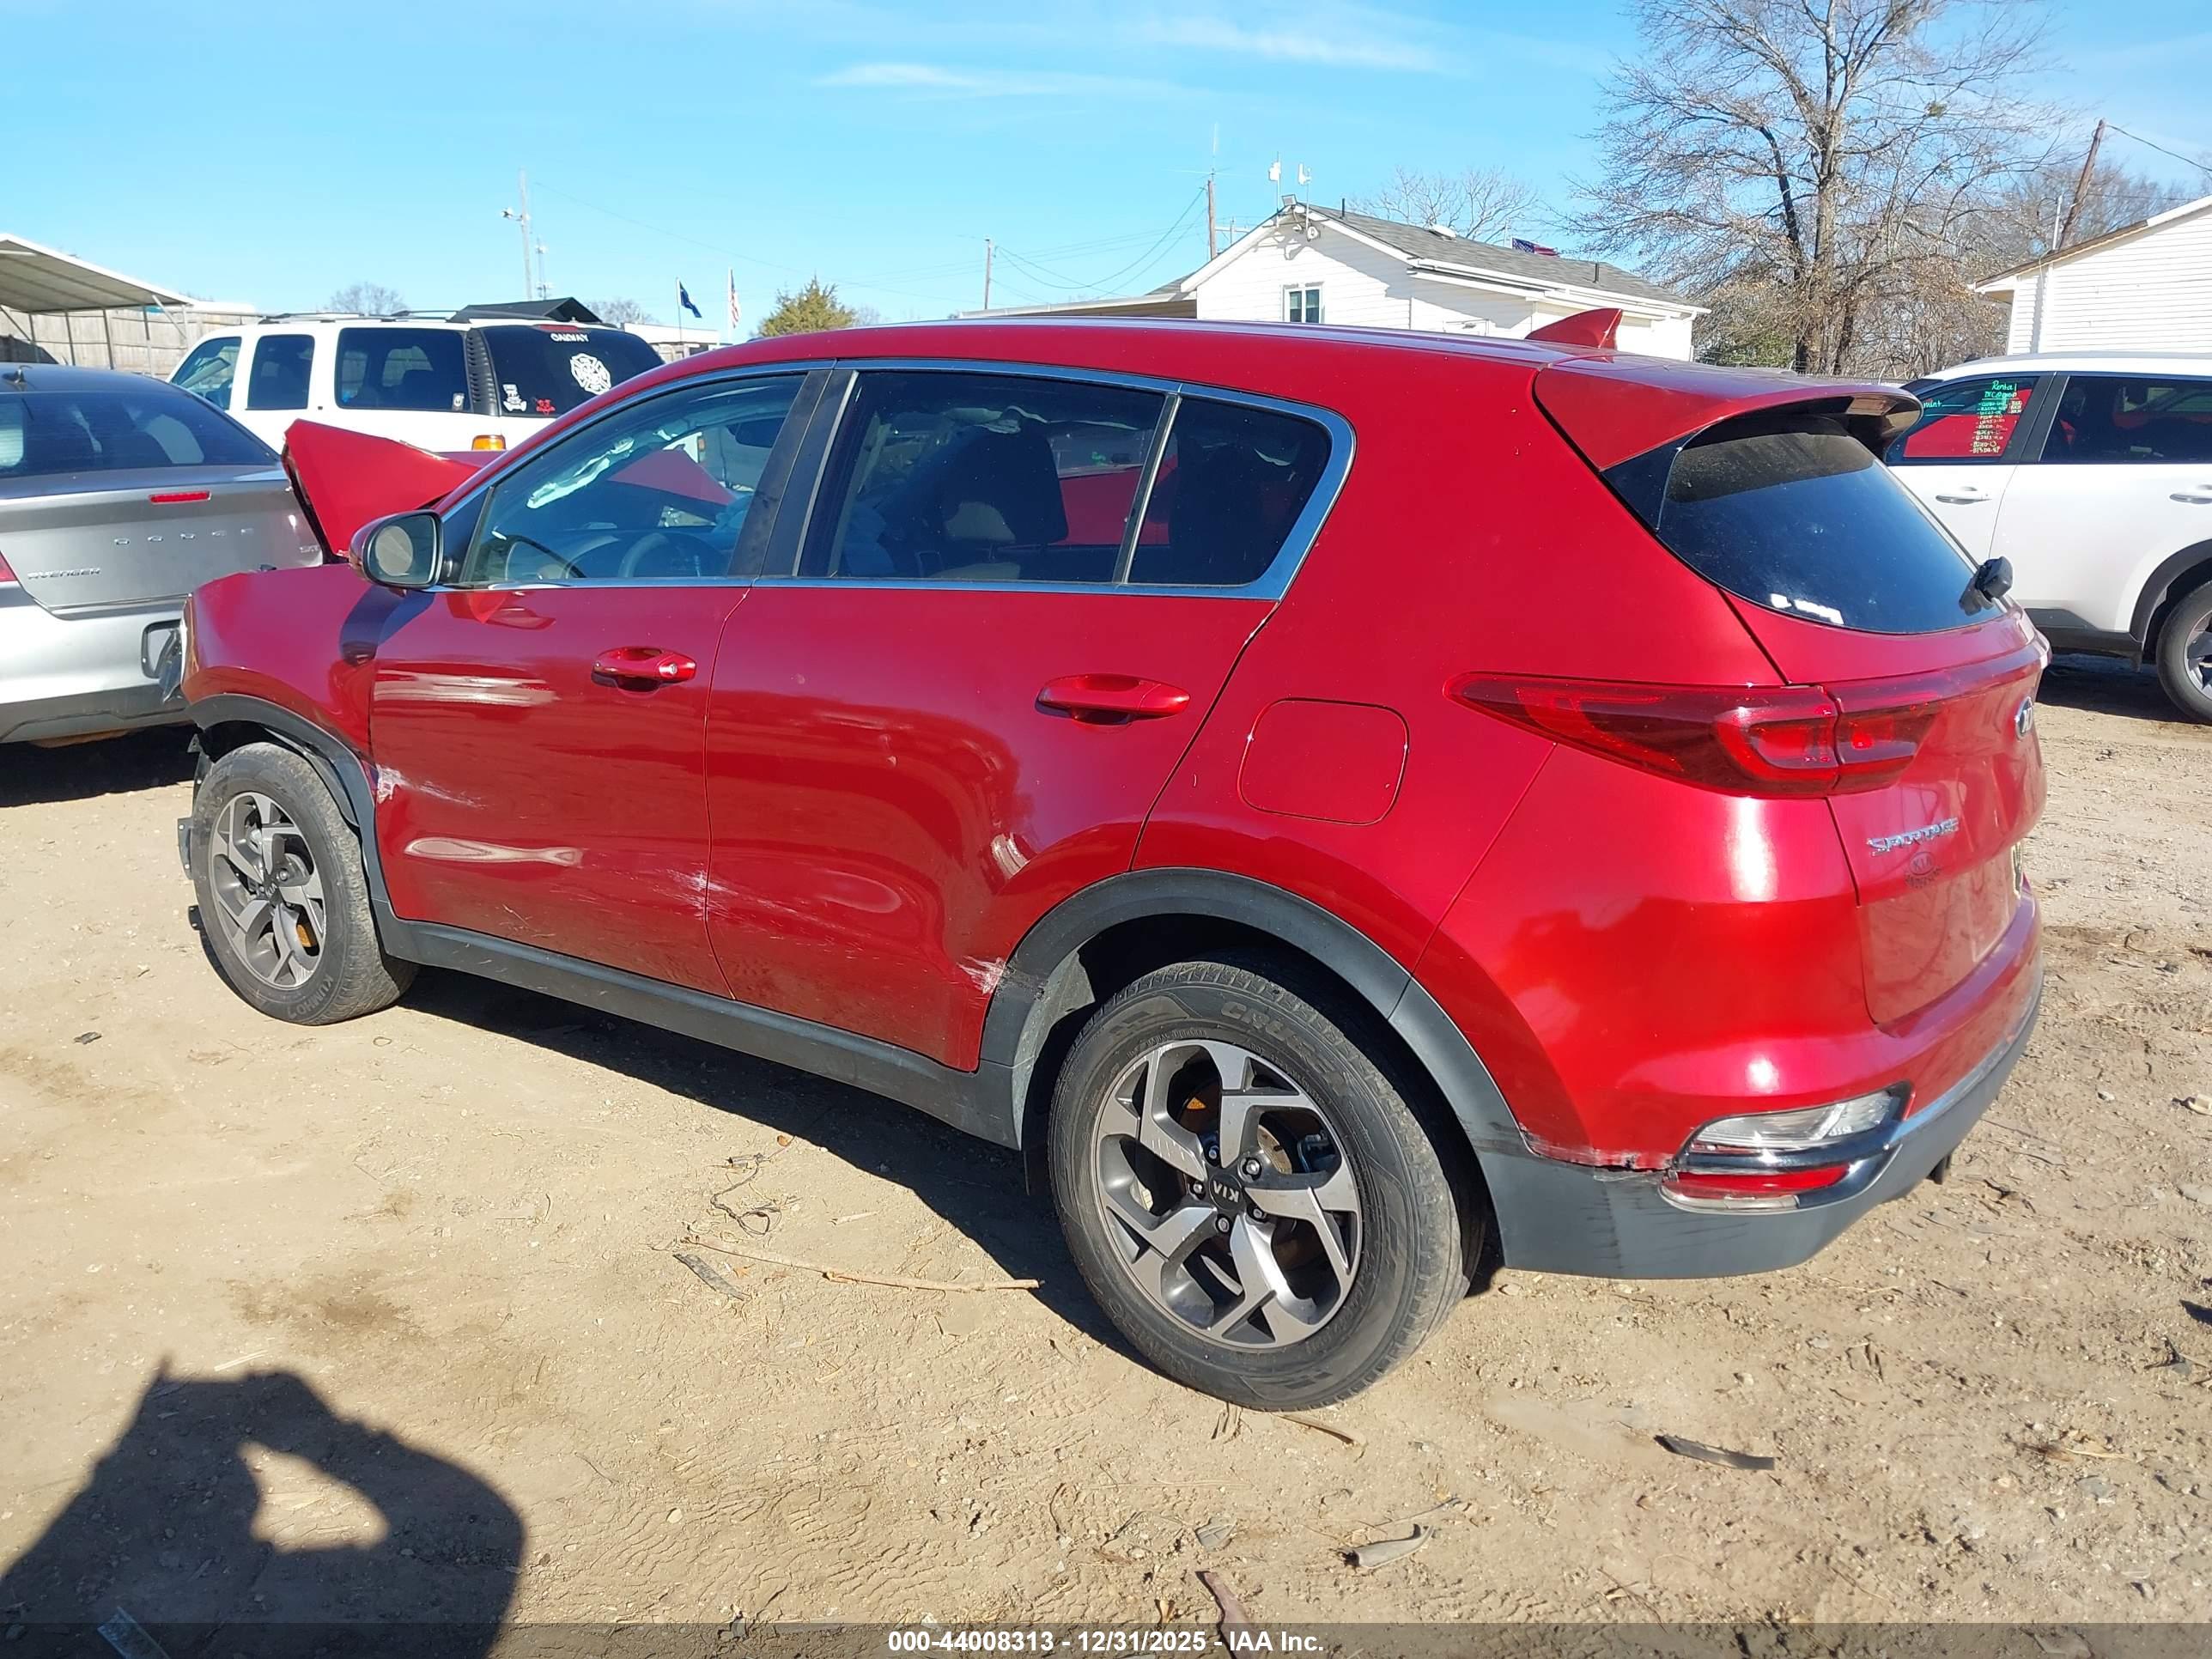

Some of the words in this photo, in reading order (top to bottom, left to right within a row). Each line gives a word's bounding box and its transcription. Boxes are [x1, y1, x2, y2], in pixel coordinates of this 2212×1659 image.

[27, 567, 100, 580] AVENGER
[1867, 817, 1959, 856] SPORTAGE
[264, 882, 278, 898] KIA
[1212, 1180, 1239, 1203] KIA
